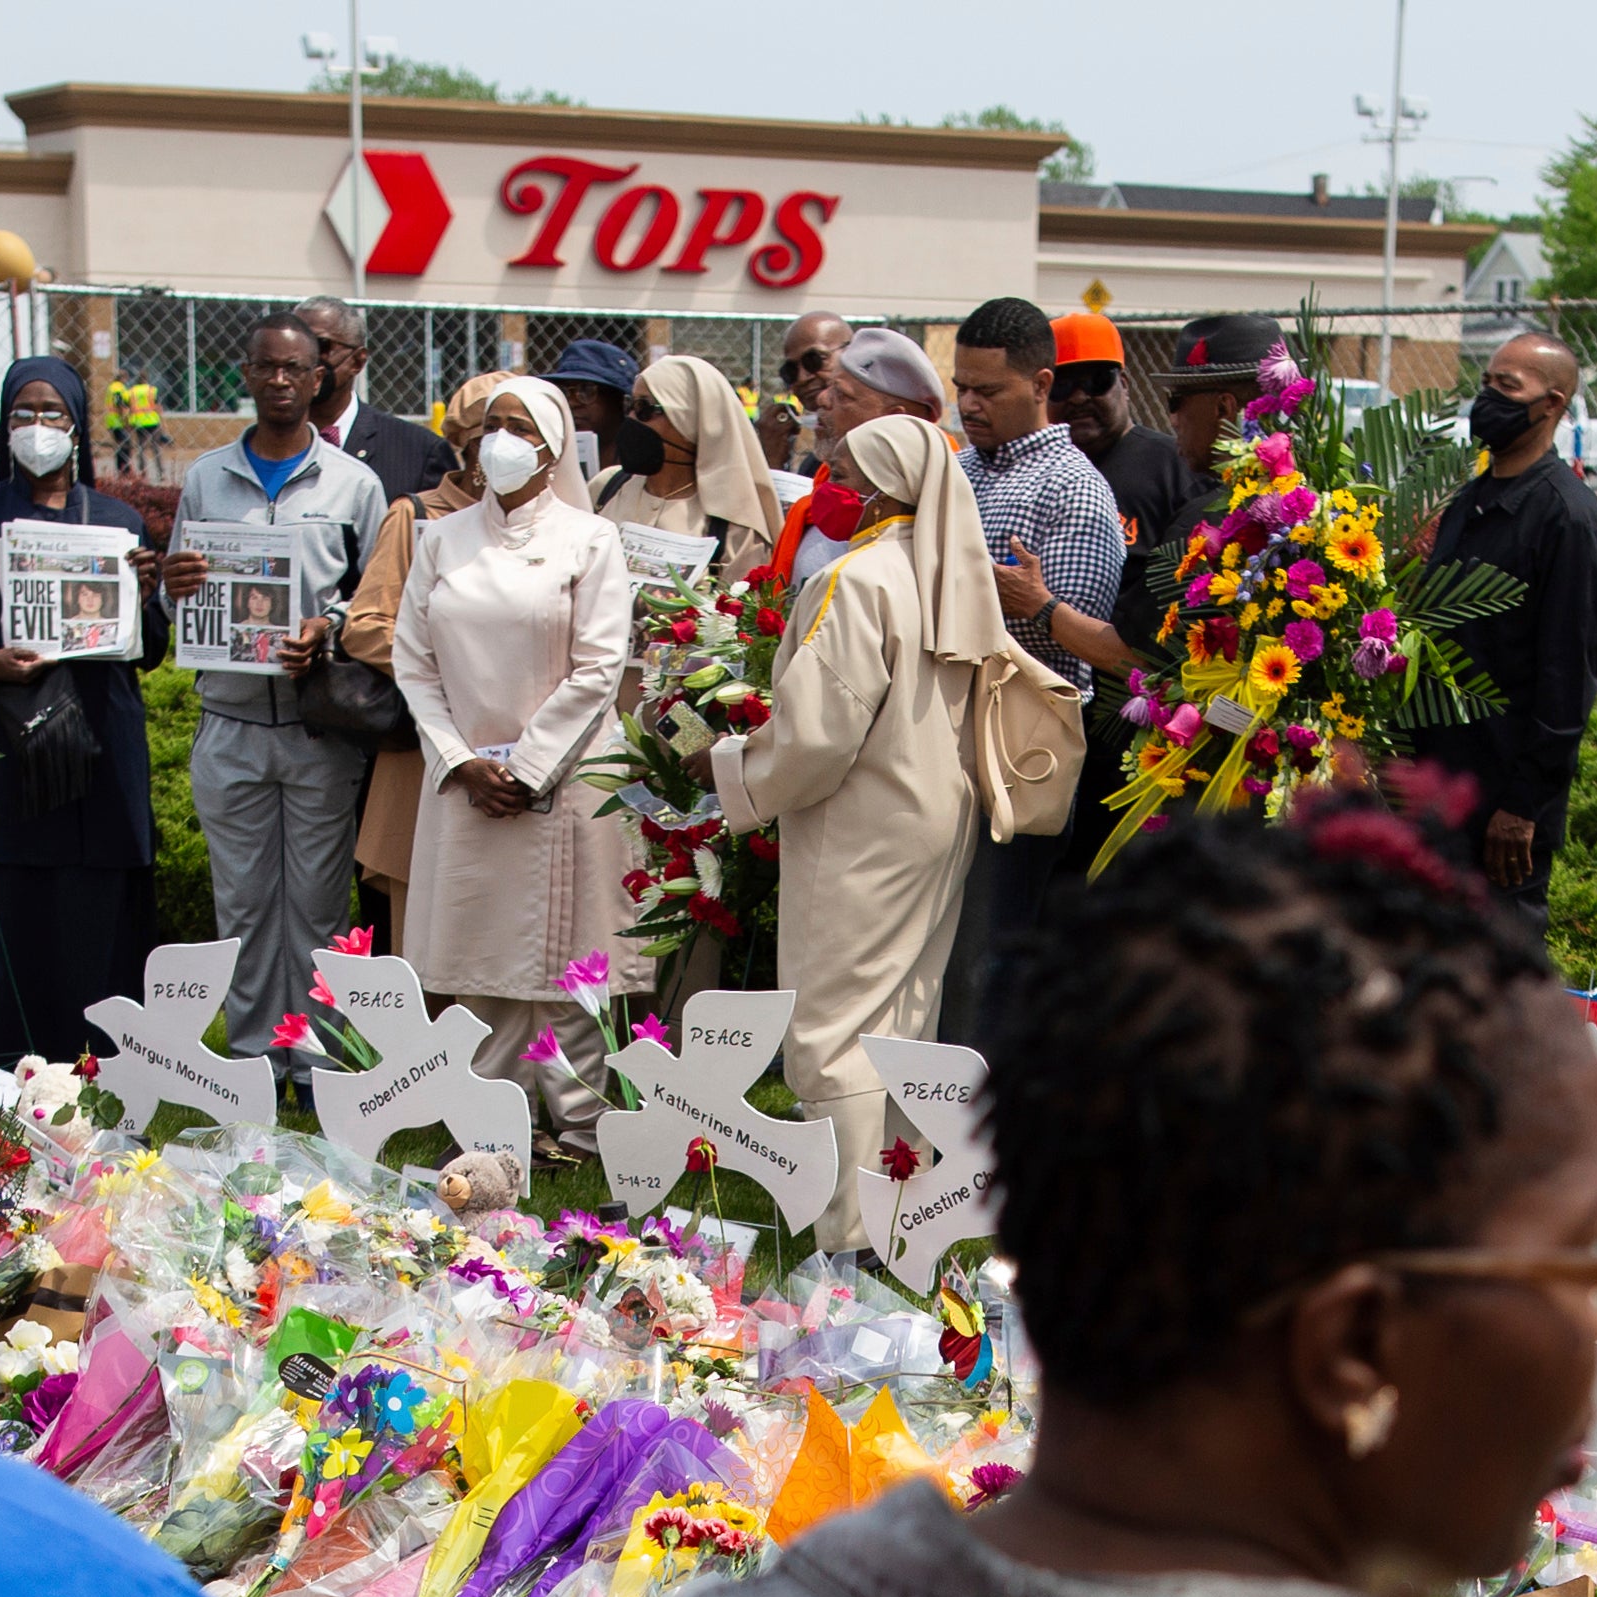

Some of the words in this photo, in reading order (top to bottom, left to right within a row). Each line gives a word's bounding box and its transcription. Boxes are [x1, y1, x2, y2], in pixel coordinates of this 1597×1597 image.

[501, 154, 841, 289] TOPS
[153, 981, 210, 1001] PEACE
[348, 989, 405, 1010] PEACE
[690, 1026, 754, 1049] PEACE
[120, 1032, 174, 1074] Margus
[174, 1058, 241, 1106] Morrison
[358, 1071, 409, 1118] Roberta
[409, 1048, 449, 1088] Drury
[902, 1080, 971, 1104] PEACE
[653, 1082, 734, 1137] Katherine
[734, 1127, 799, 1176] Massey
[616, 1172, 662, 1190] 5-14-22
[899, 1182, 972, 1233] Celestine
